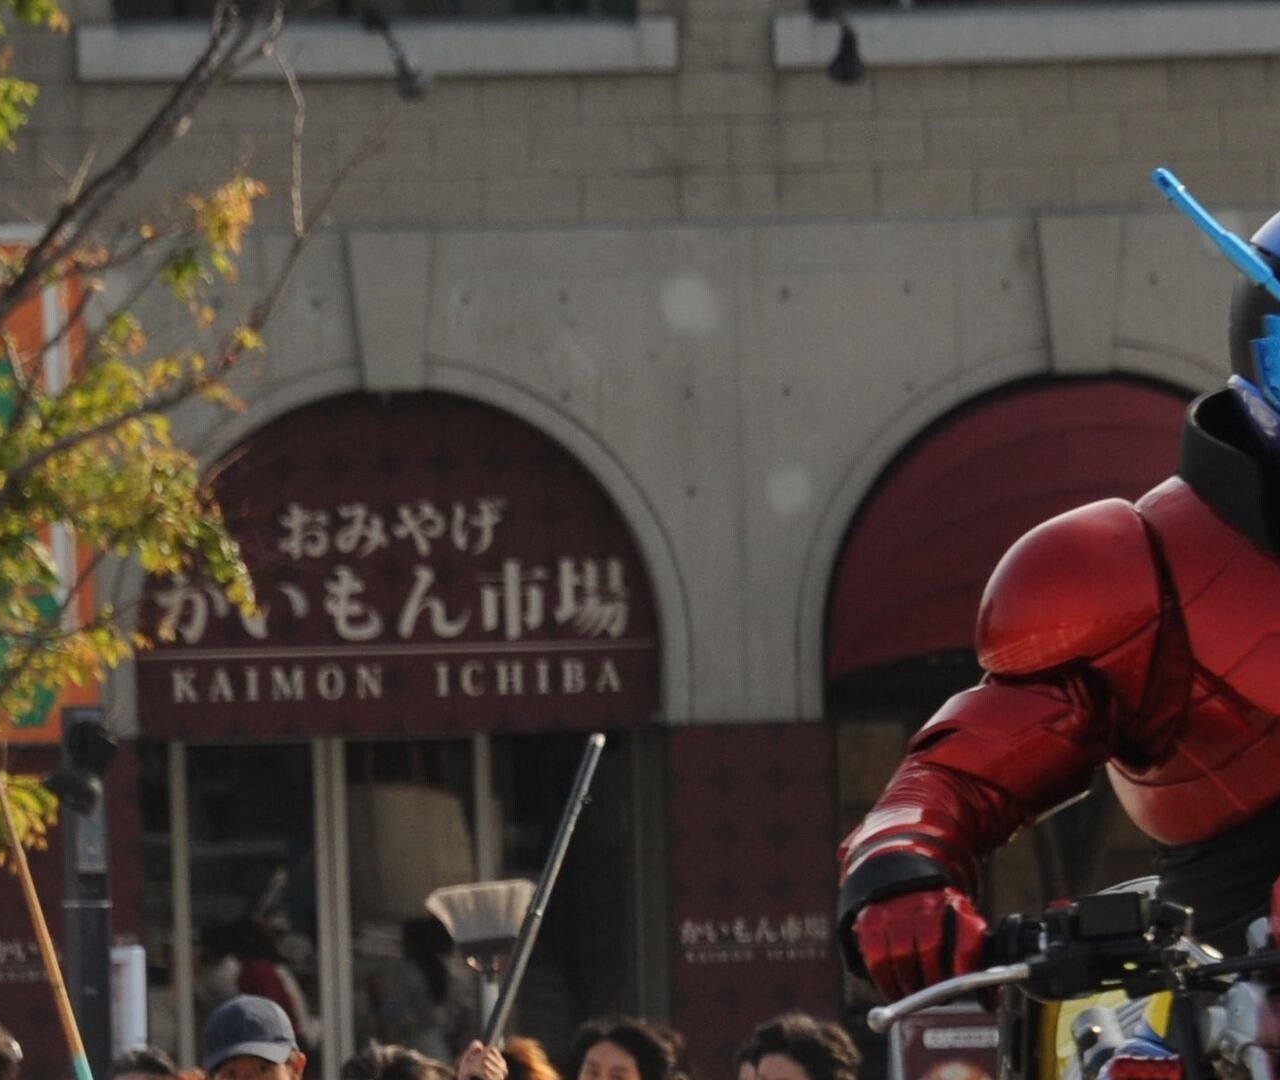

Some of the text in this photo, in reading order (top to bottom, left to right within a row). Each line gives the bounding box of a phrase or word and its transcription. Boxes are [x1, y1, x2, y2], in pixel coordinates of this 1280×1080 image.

[277, 497, 506, 558] おみやげ
[154, 558, 629, 645] かいもん市場
[171, 657, 623, 704] KAIMON ICHIBA
